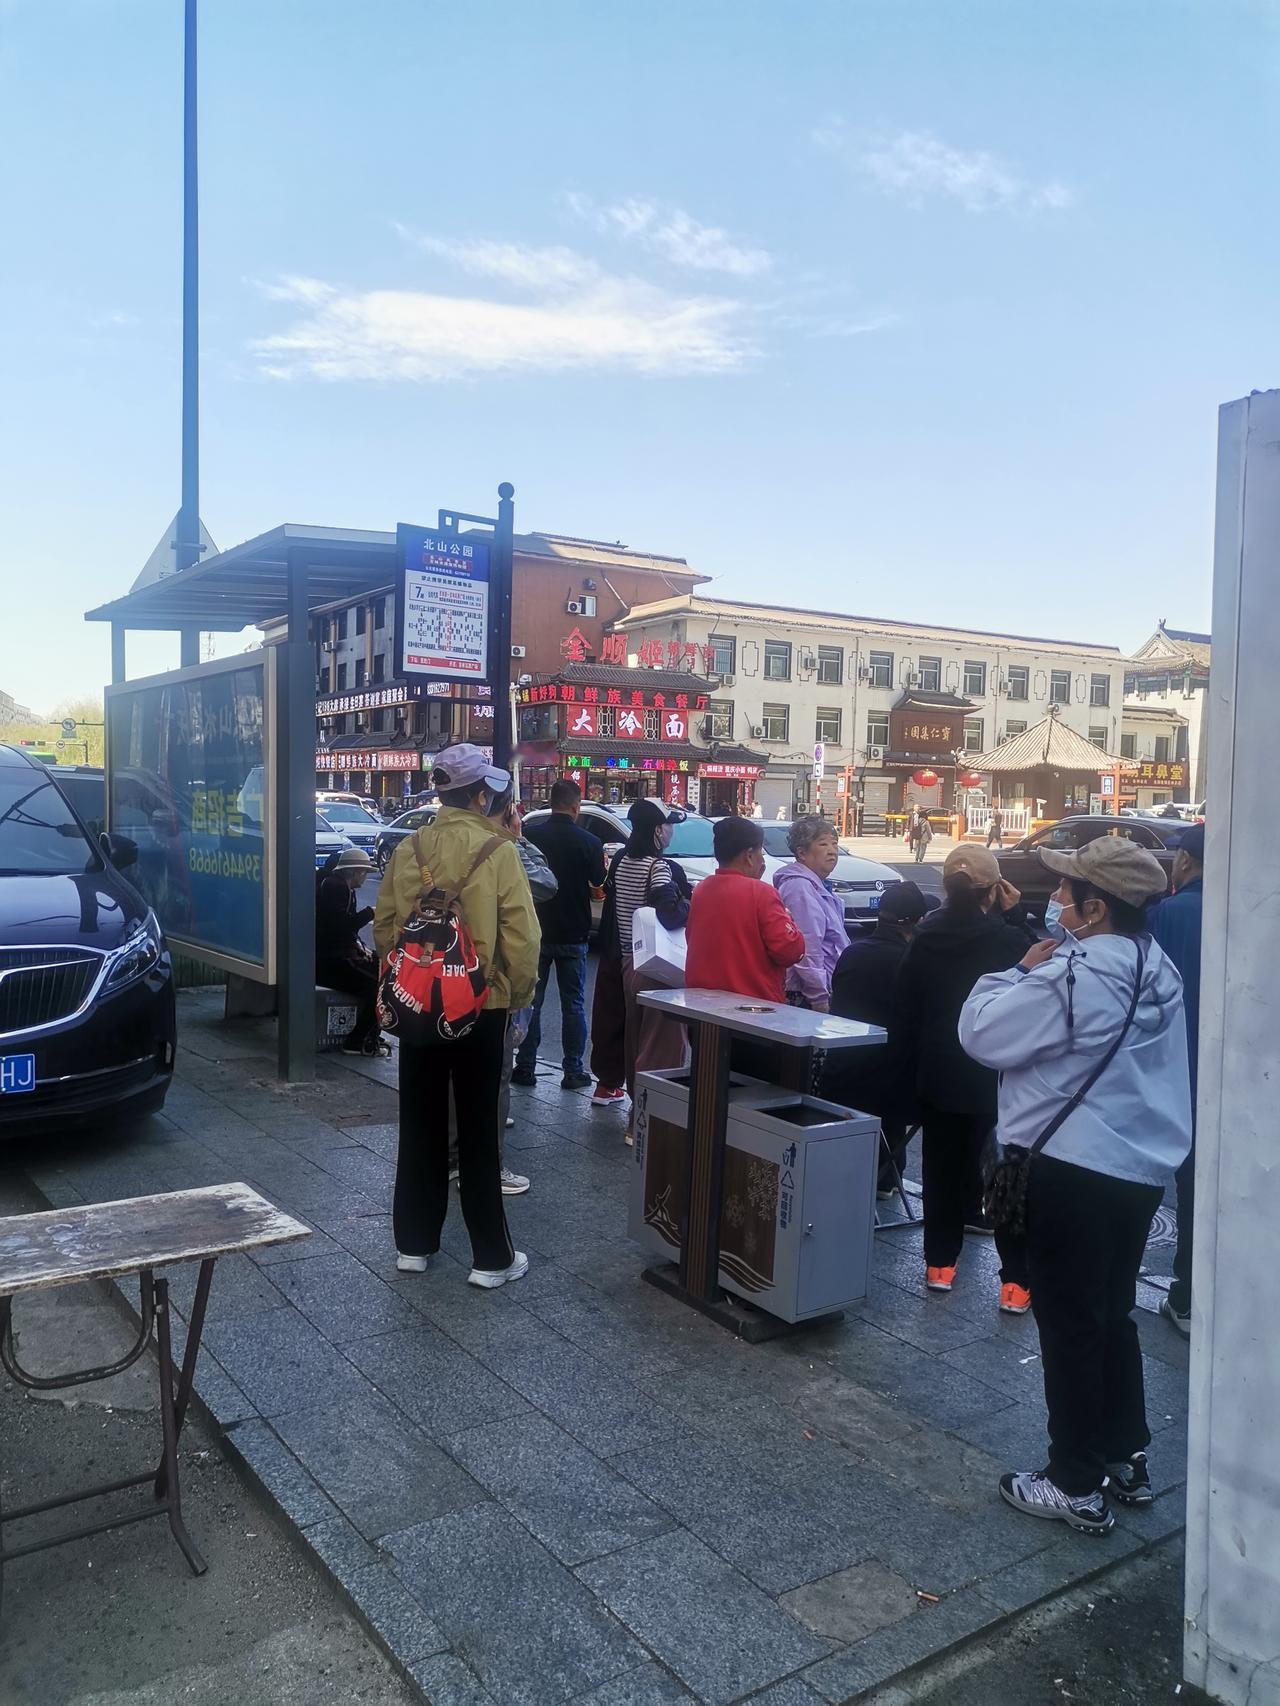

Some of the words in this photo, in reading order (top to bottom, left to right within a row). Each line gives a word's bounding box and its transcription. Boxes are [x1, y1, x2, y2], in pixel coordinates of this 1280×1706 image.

[423, 538, 473, 558] 北山公园
[560, 684, 709, 710] 朝鲜族美食餐厅
[571, 709, 685, 738] 大冷面
[1, 1060, 31, 1088] HJ
